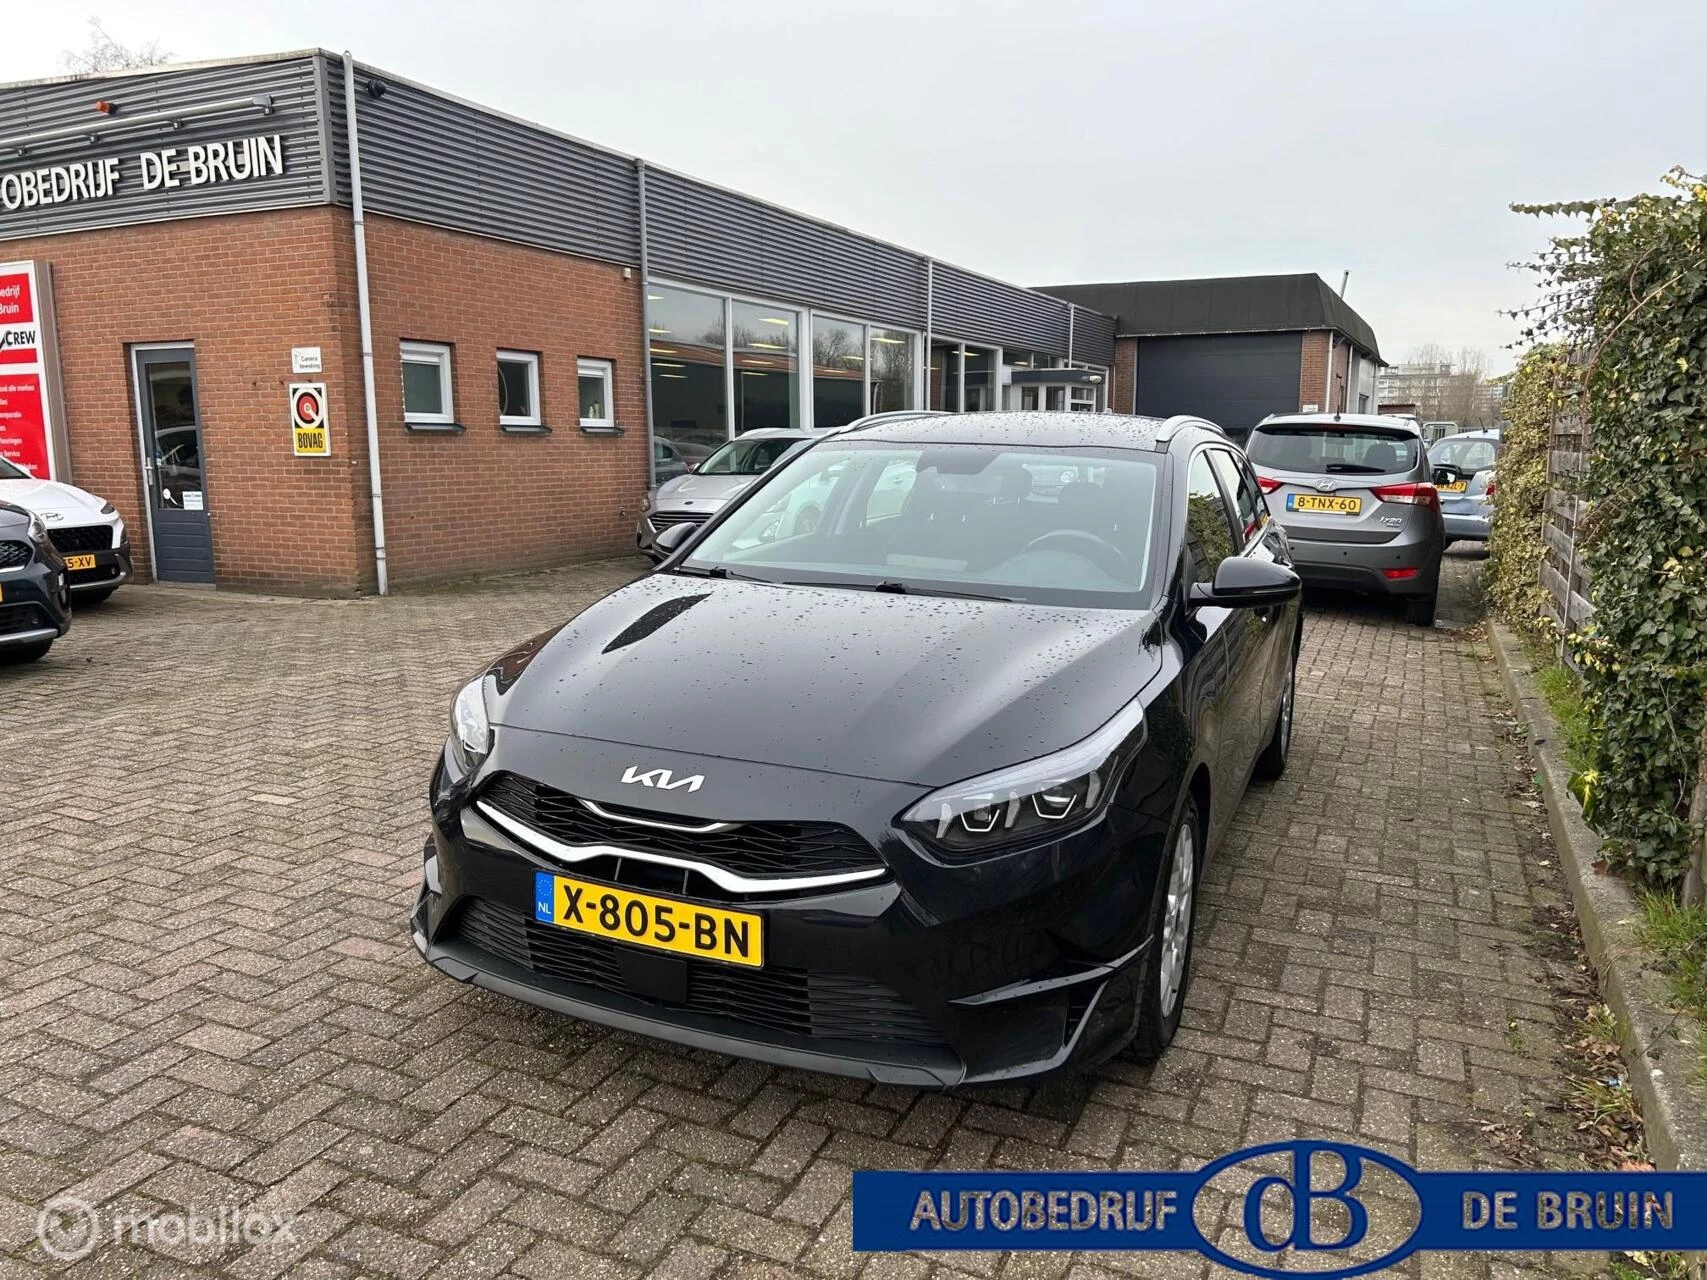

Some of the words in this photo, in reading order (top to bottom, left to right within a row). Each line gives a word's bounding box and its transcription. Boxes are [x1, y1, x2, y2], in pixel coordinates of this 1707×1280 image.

[0, 158, 120, 209] OBEDRIJF
[140, 149, 181, 190] DE
[187, 134, 284, 184] BRUIN
[5, 330, 36, 346] CREW
[297, 432, 323, 449] BOVAG
[1298, 496, 1357, 511] 8-TNX-60
[621, 765, 705, 792] KIA
[538, 901, 551, 914] NL
[563, 884, 749, 958] X-805-BN
